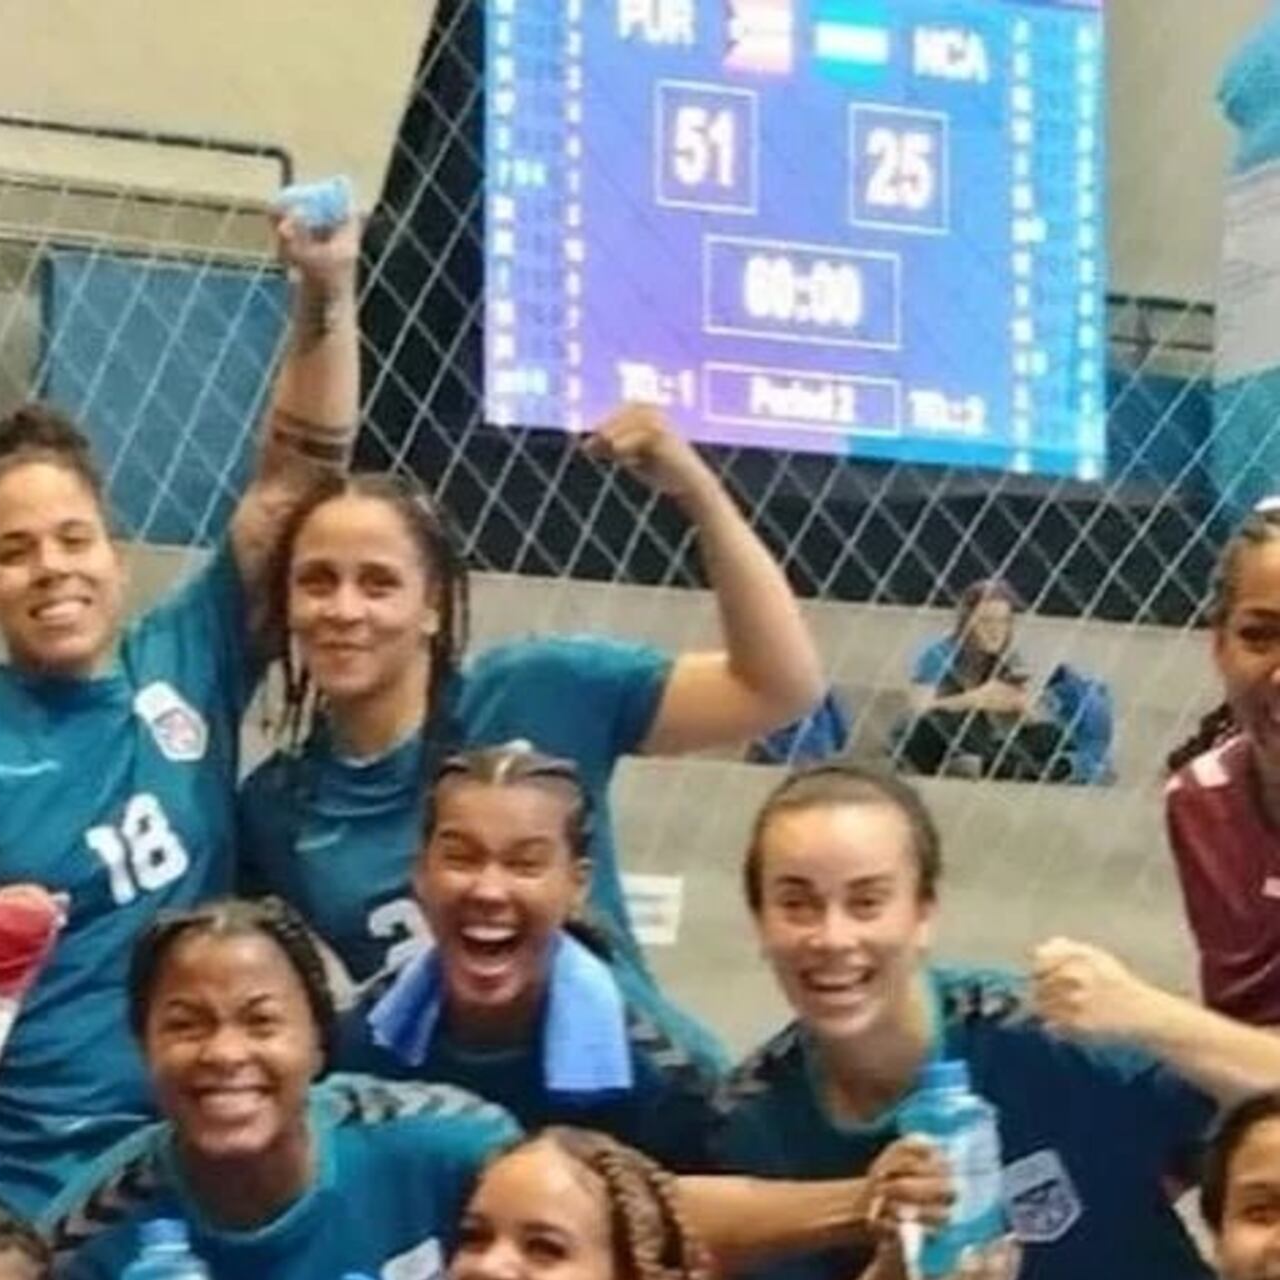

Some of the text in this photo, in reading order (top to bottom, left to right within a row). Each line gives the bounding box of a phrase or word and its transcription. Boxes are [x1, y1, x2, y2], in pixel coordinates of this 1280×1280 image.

[618, 0, 695, 44] PUR
[674, 106, 734, 188] 51
[865, 127, 933, 210] 25
[85, 792, 189, 904] 18
